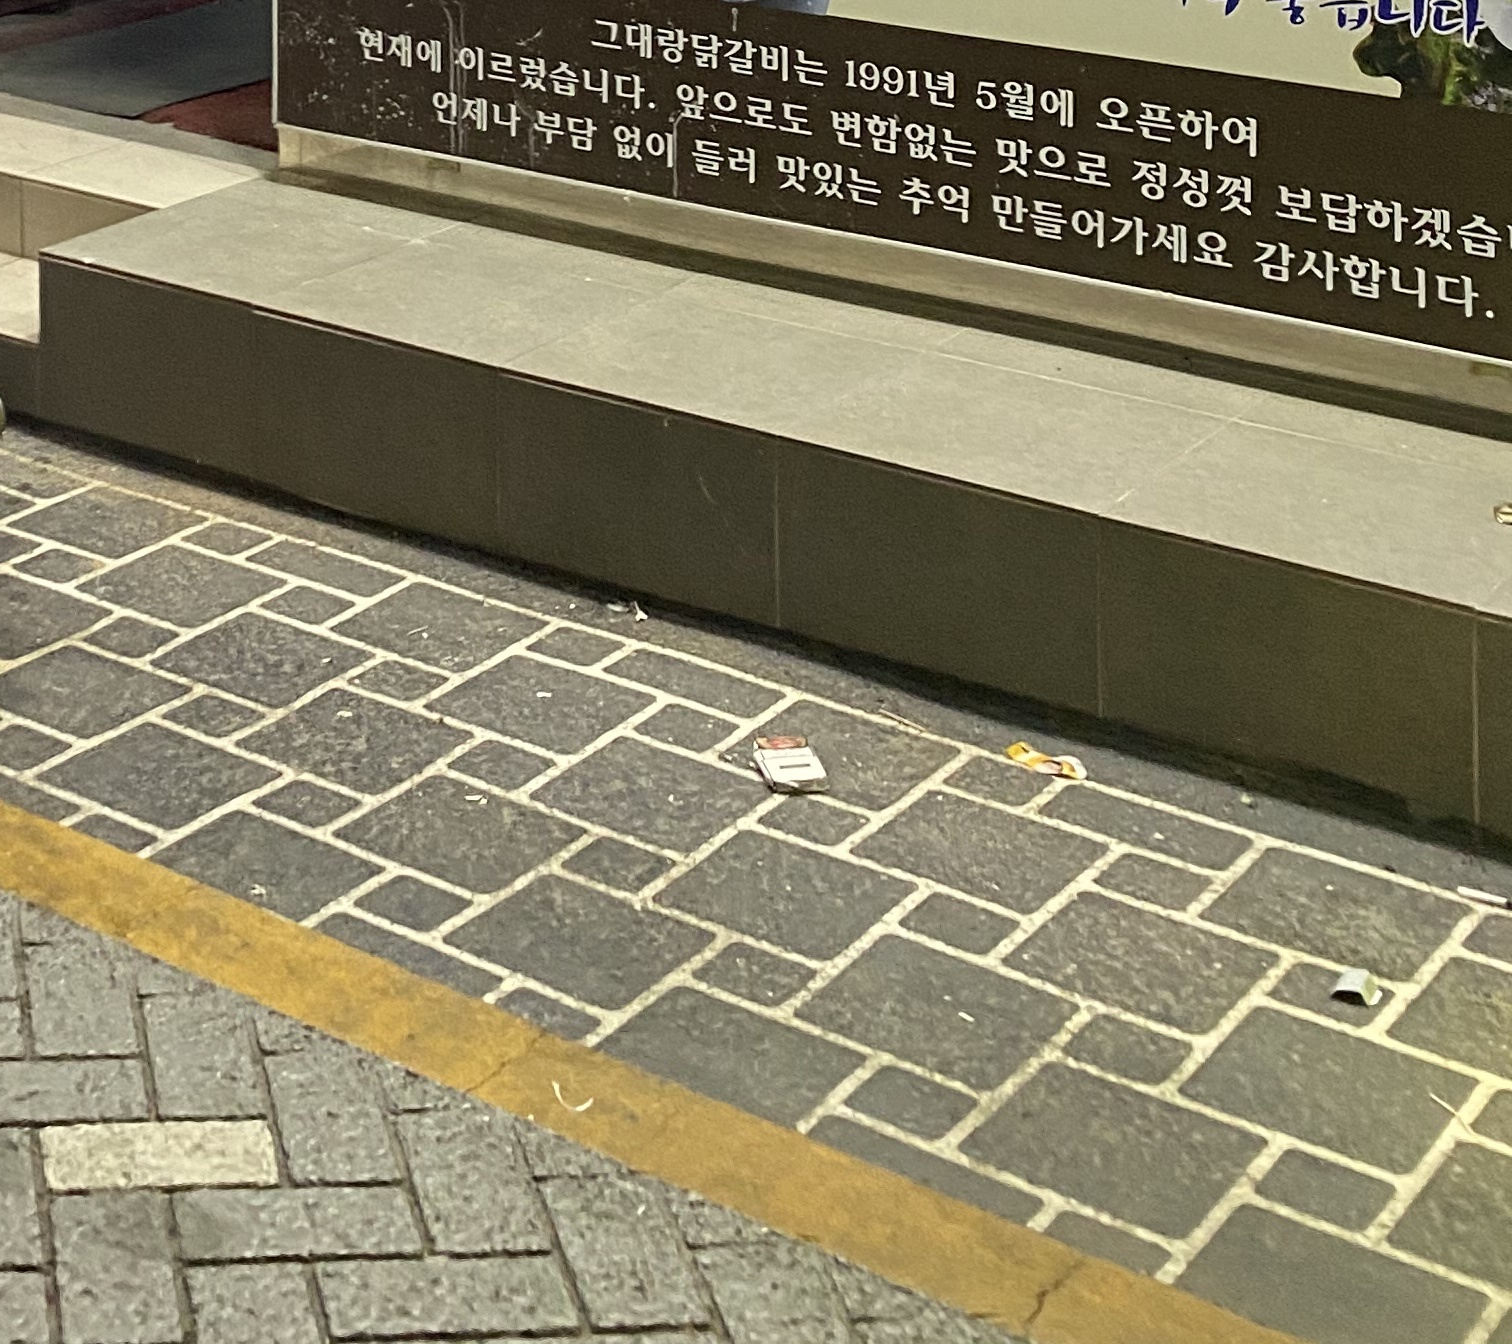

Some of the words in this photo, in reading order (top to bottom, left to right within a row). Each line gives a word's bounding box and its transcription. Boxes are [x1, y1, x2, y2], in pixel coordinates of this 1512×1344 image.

[358, 26, 442, 73] 현재에
[676, 84, 813, 137] 앞으로도
[830, 110, 976, 168] 변함없는
[996, 137, 1111, 189] 맛으로
[1132, 161, 1253, 217] 정성껏
[1275, 185, 1512, 260] 보답하겠습
[591, 19, 827, 86] 그대랑닭갈비는
[844, 59, 955, 108] 1991년
[975, 81, 1076, 129] 5월에
[1095, 95, 1259, 158] 오픈하여
[432, 91, 521, 138] 언제나
[533, 109, 598, 152] 부담
[613, 125, 675, 169] 없이
[691, 139, 758, 184] 들러
[776, 155, 883, 207] 맛있는
[899, 178, 973, 224] 추억
[991, 194, 1234, 270] 만들어가세요
[1253, 240, 1496, 319] 감사합니다.
